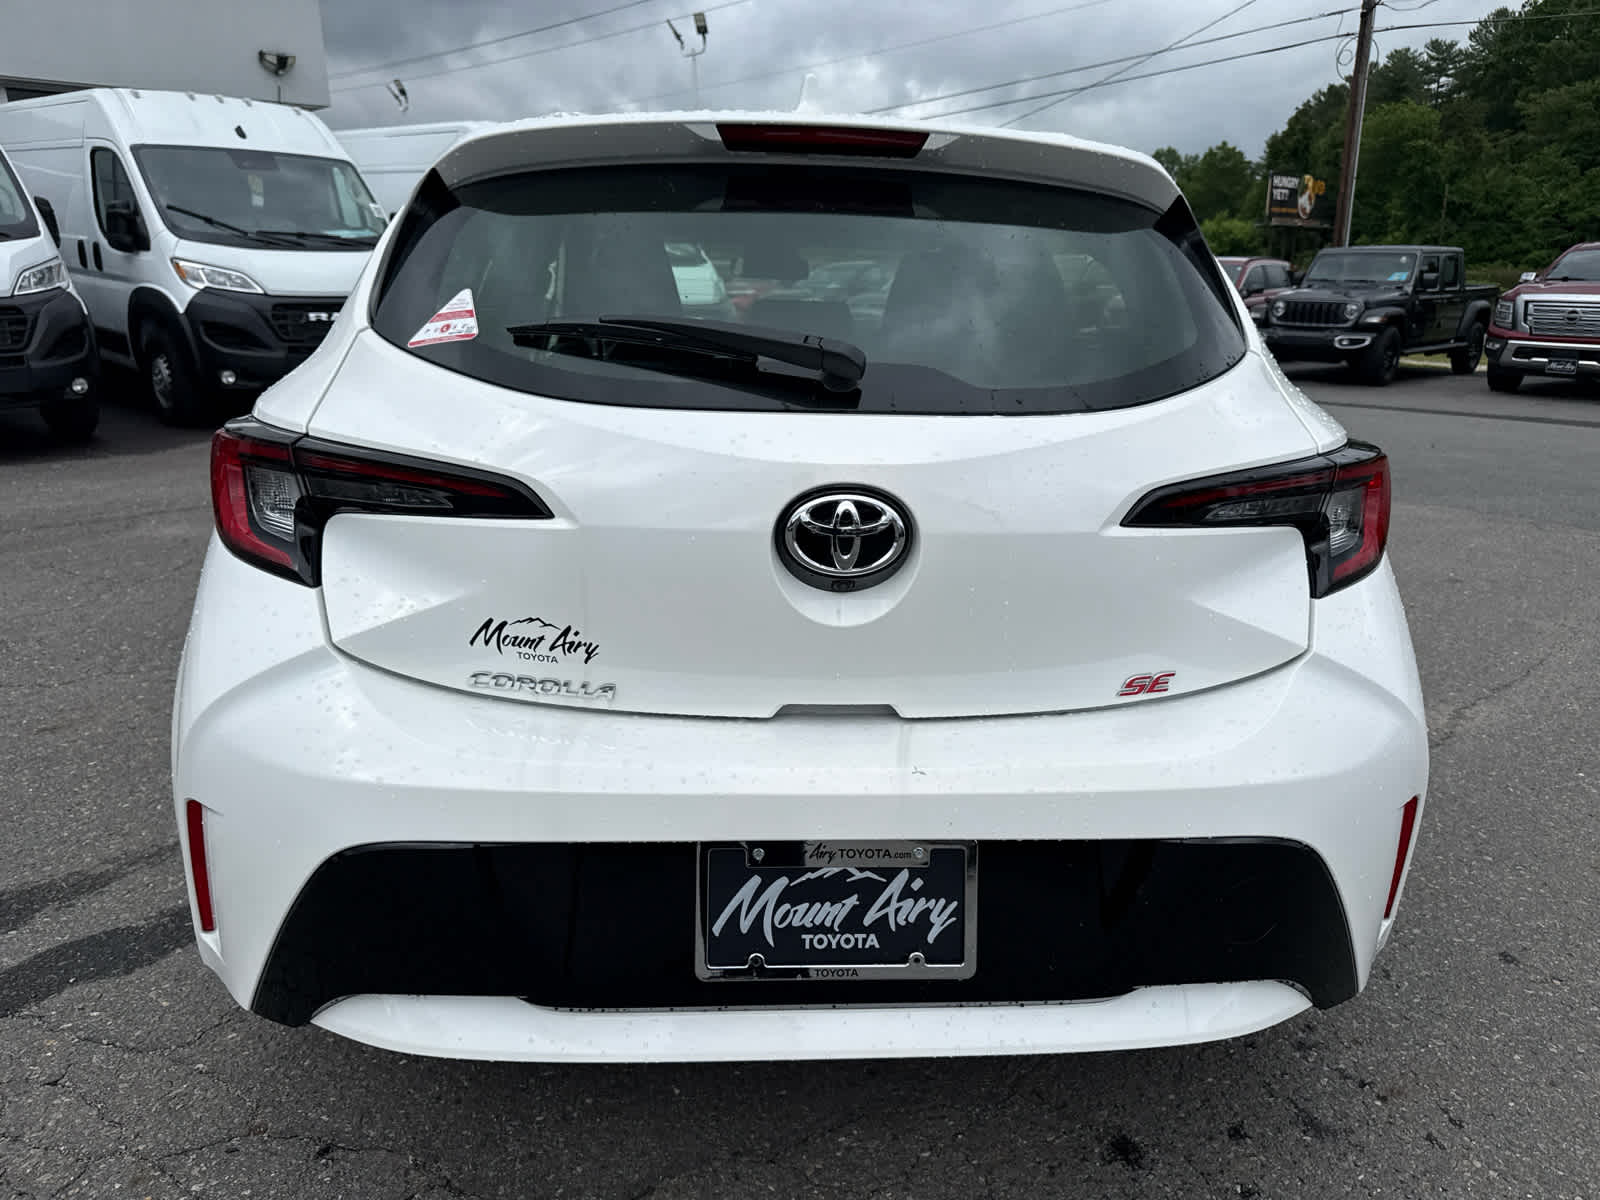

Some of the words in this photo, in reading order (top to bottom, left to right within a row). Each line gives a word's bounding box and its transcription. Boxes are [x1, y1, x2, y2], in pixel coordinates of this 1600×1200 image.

[469, 617, 546, 655] Mount
[549, 625, 600, 664] Airy
[516, 651, 559, 664] TOYOTA
[469, 671, 617, 700] COROLLA
[1116, 670, 1176, 697] SE
[808, 842, 837, 864] Airy
[711, 874, 860, 948] Mount
[862, 868, 958, 944] Airy
[801, 933, 880, 950] TOYOTA
[815, 968, 859, 978] TOYOTA
